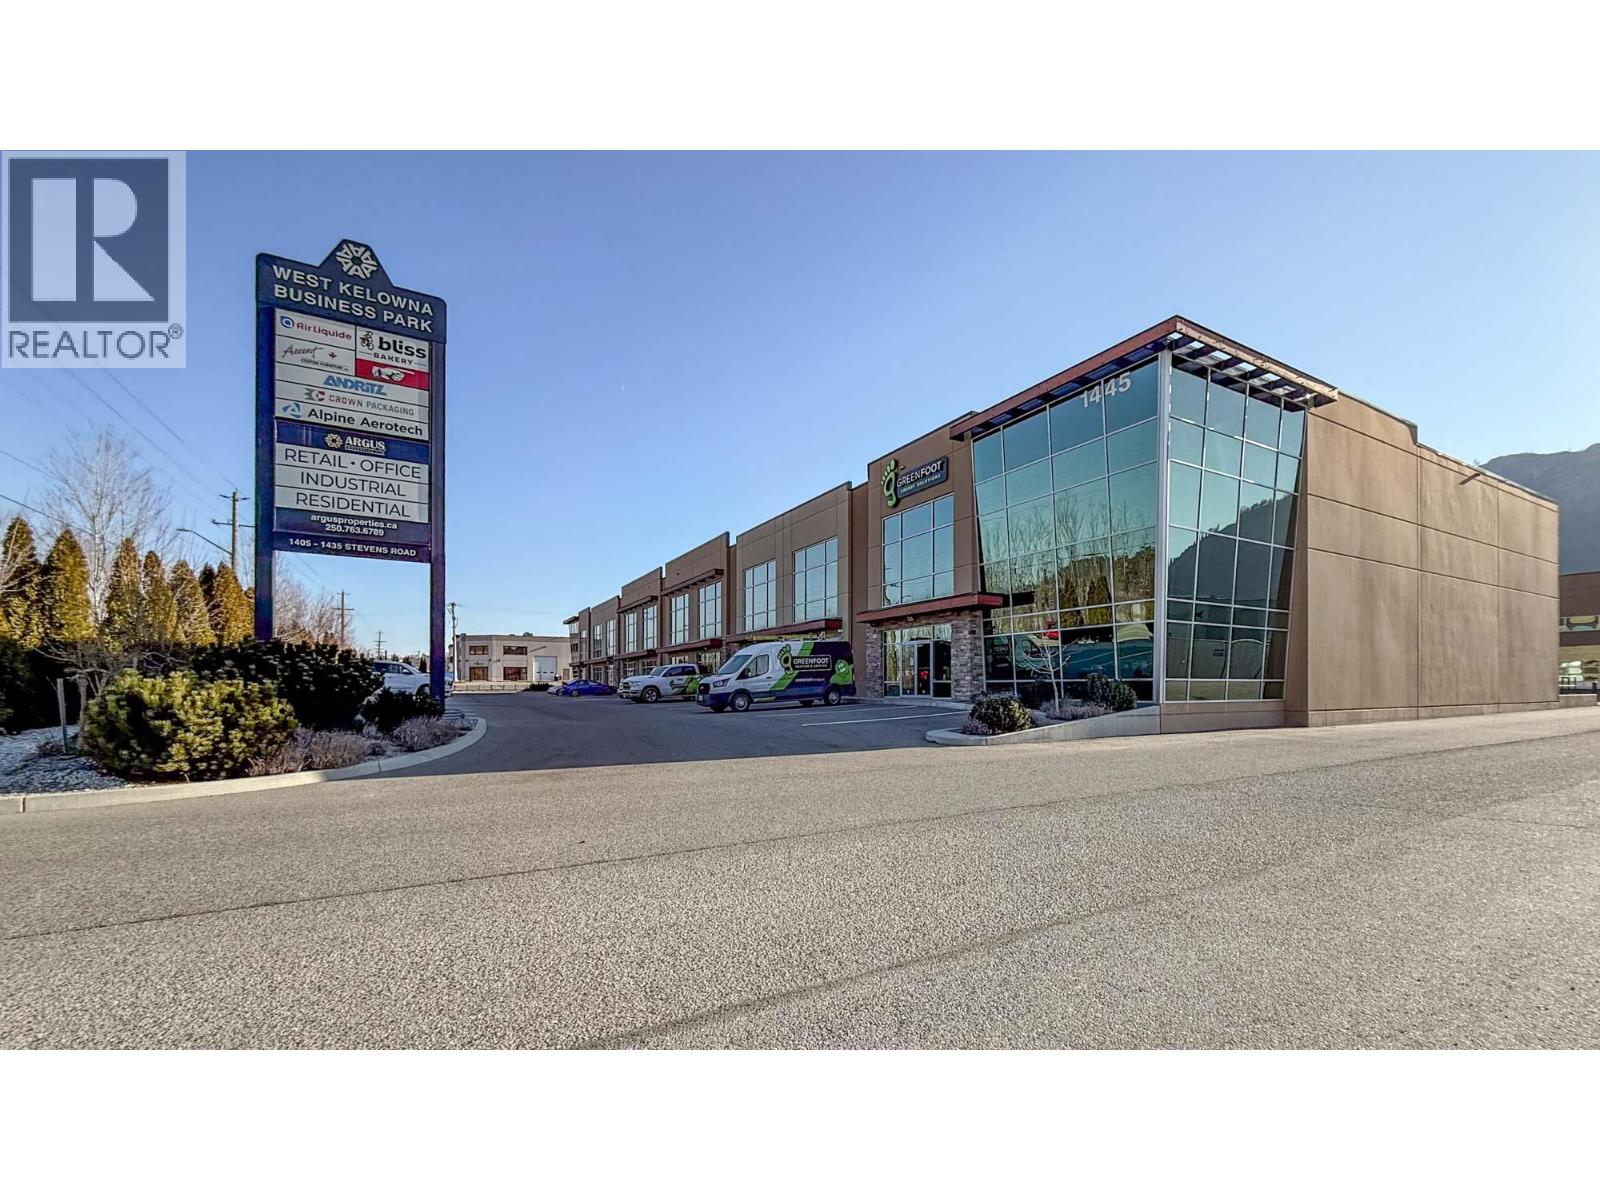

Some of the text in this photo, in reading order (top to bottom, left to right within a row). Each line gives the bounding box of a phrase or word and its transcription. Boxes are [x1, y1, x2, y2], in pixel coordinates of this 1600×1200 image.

[272, 264, 433, 316] WEST KELOWNA
[274, 284, 433, 333] BUSINESS PARK
[373, 352, 414, 366] BAKERY
[378, 336, 427, 360] bliss
[1080, 371, 1132, 408] 1445
[329, 394, 415, 416] CROWN PACKAGING
[307, 407, 423, 436] Alpine Aerotech
[345, 435, 386, 450] ARGUS
[284, 448, 348, 469] RETAIL
[360, 459, 422, 479] OFFICE
[896, 460, 942, 488] GREENFOOT
[300, 471, 407, 497] INDUSTRIAL
[296, 492, 411, 518] RESIDENTIAL
[310, 514, 398, 530] argusproperties.ca
[325, 523, 385, 536] 250.763.6789
[320, 540, 343, 550] 1435
[344, 543, 389, 555] STEVENS
[390, 547, 417, 557] ROAD
[793, 657, 829, 665] GREENFOOT
